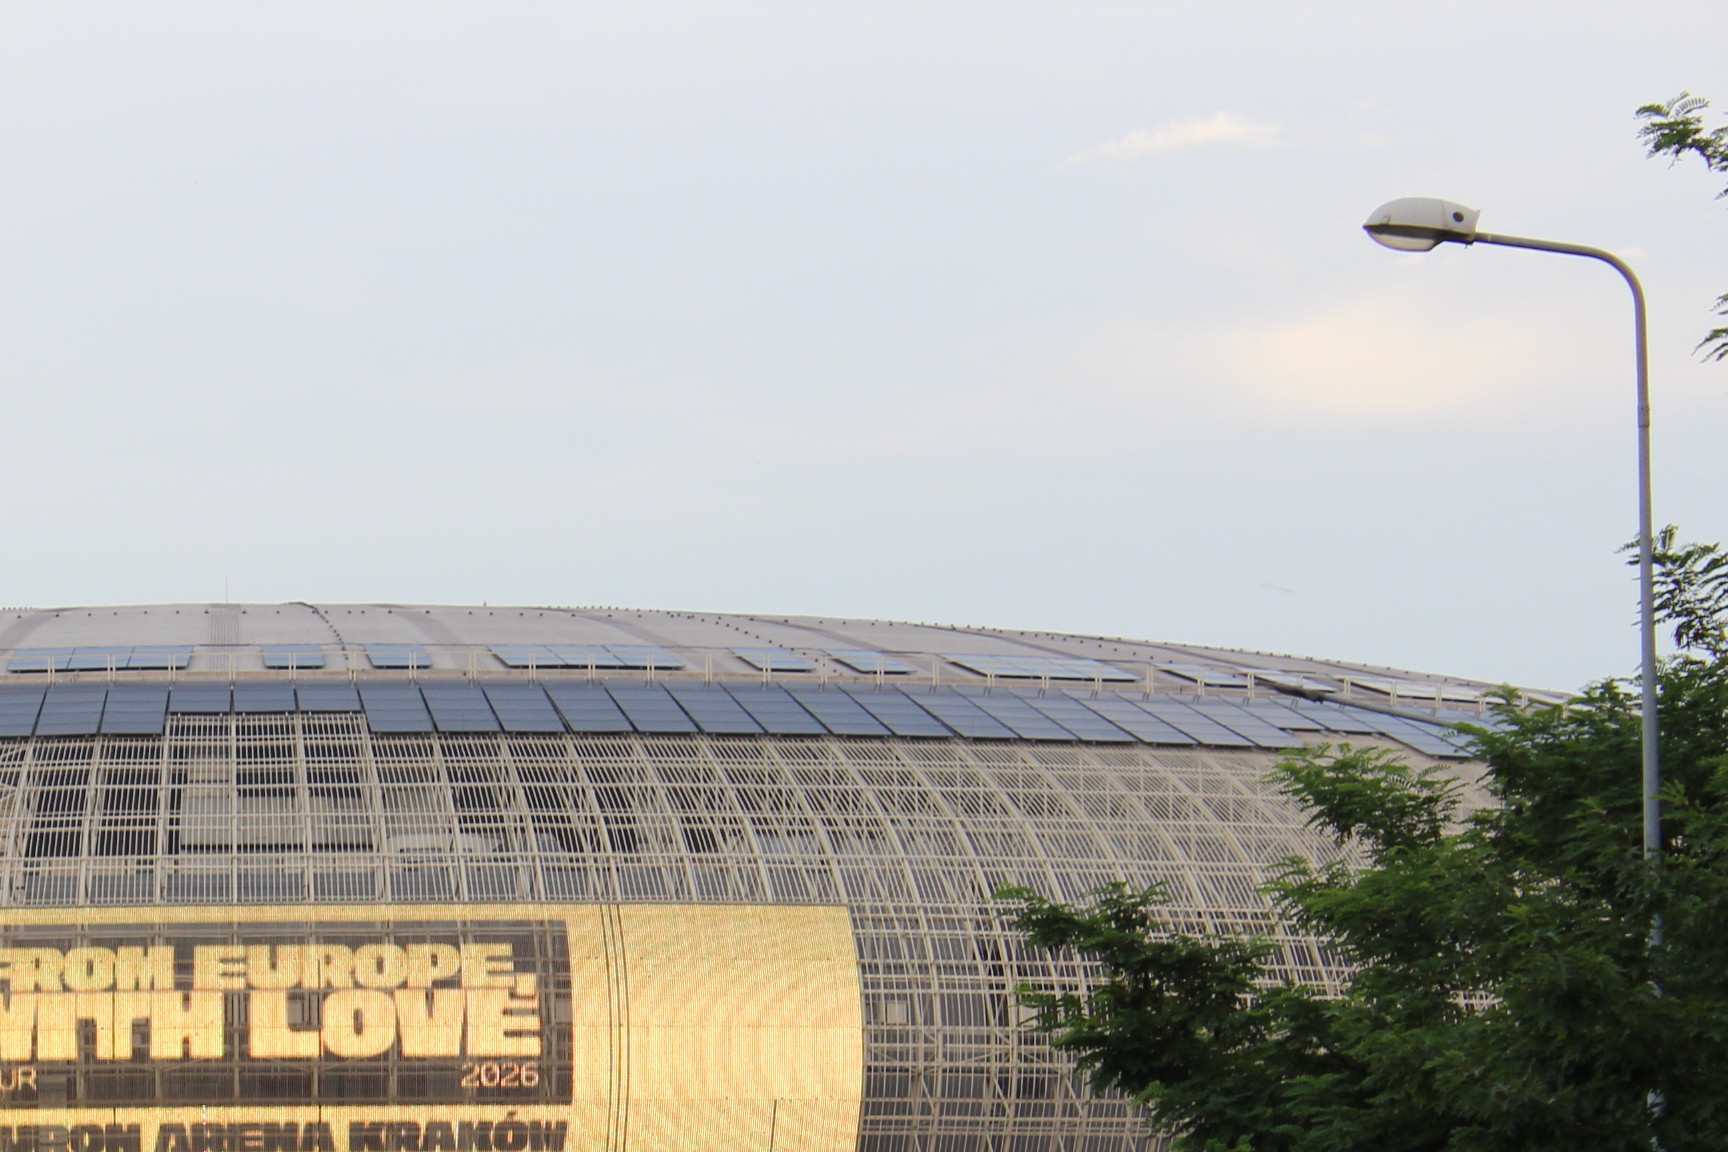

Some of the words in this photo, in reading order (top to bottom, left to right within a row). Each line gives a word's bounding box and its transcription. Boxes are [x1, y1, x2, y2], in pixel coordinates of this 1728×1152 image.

[249, 989, 541, 1058] LOVE
[461, 1062, 538, 1088] 2026
[349, 1111, 567, 1152] KRAKÓW
